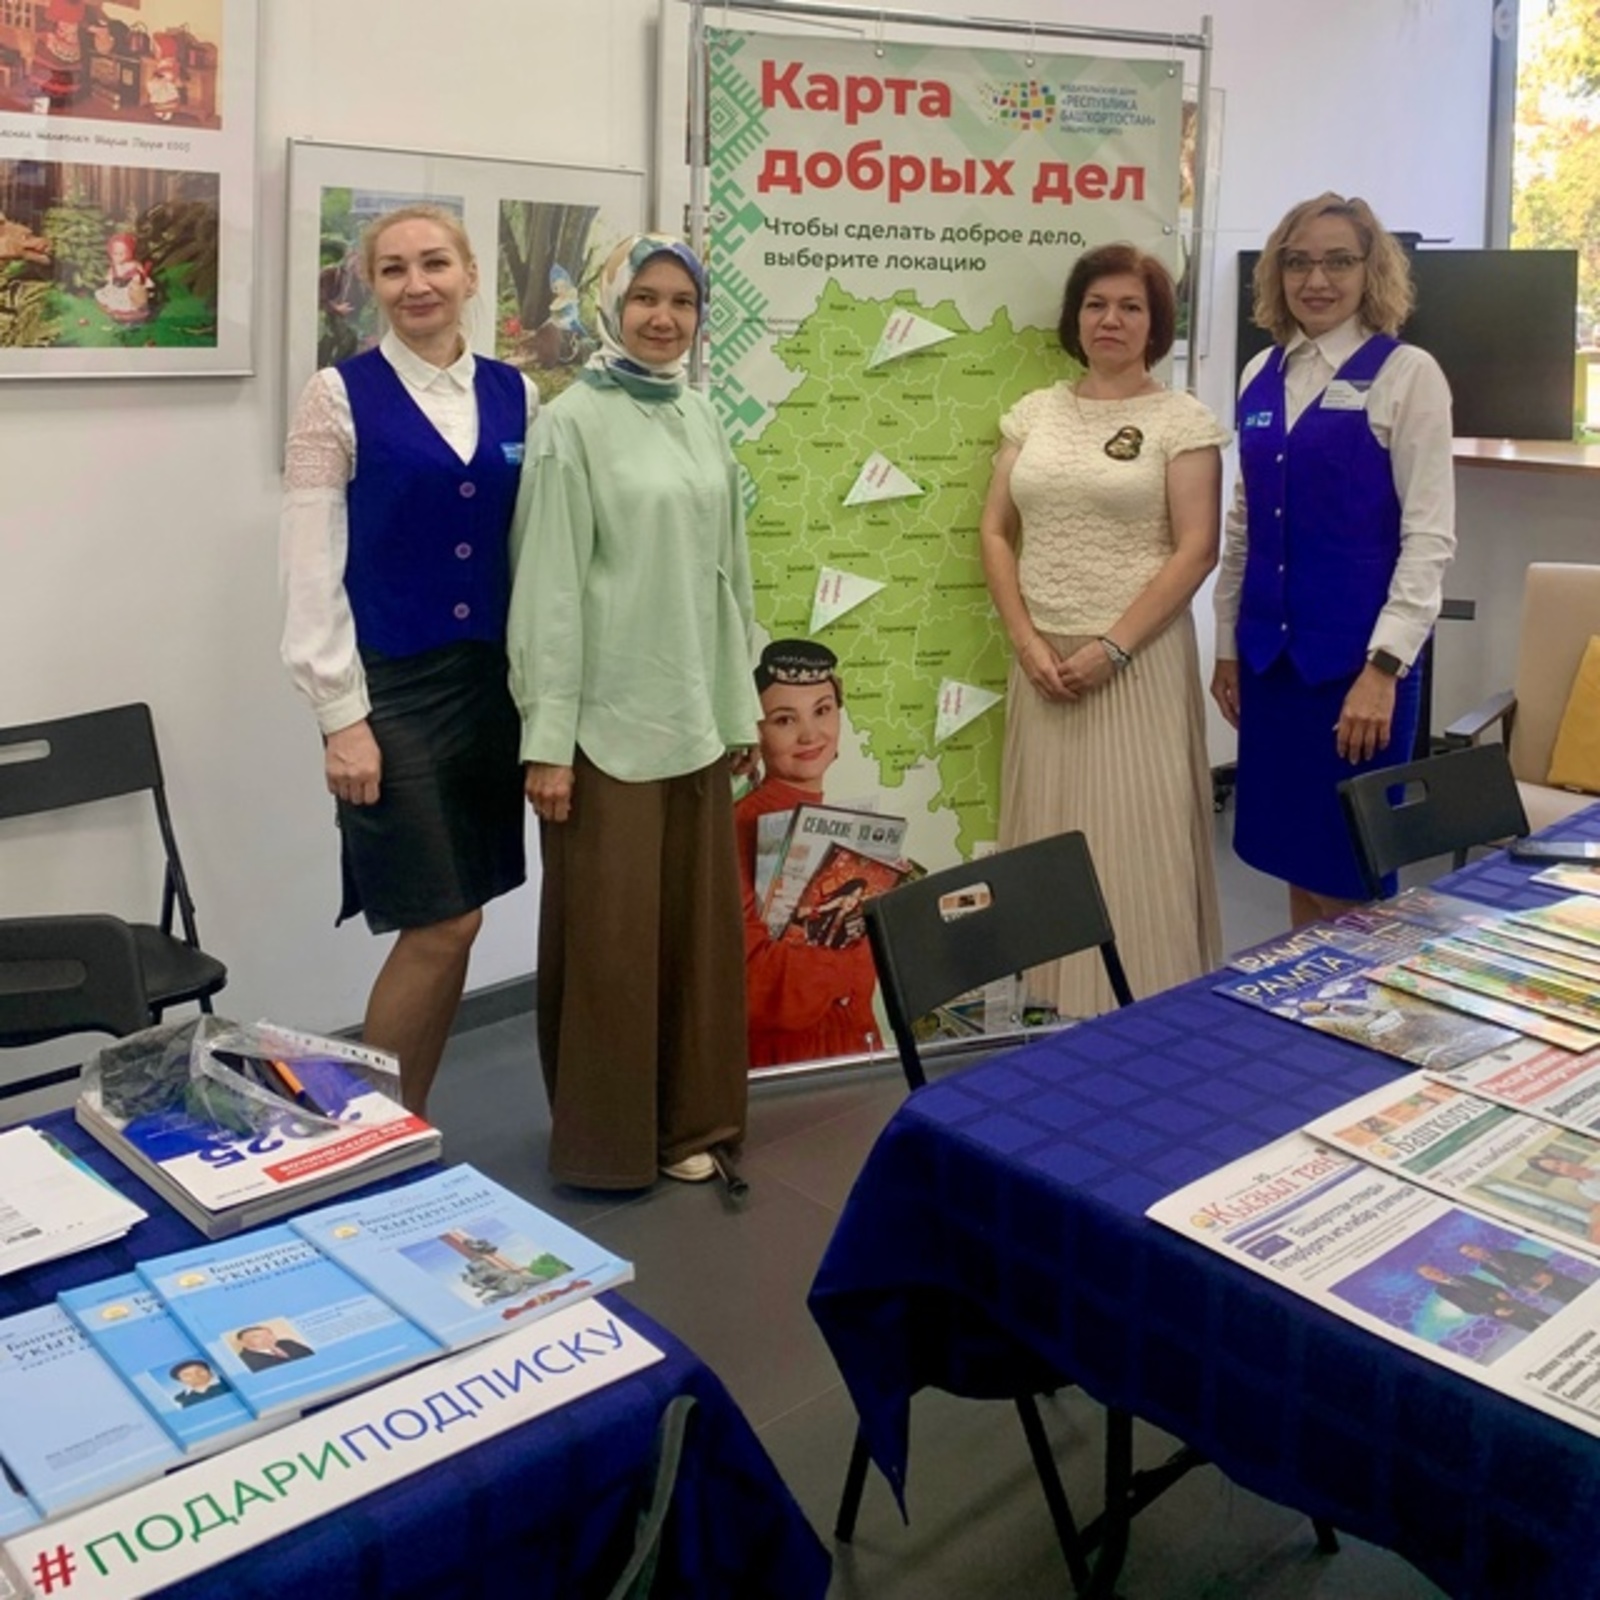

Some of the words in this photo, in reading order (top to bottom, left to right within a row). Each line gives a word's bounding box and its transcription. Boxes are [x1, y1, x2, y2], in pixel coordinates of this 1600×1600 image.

[760, 60, 952, 125] Карта
[758, 139, 1016, 203] добрых
[1032, 161, 1146, 205] дел
[764, 217, 838, 238] Чтобы
[845, 222, 935, 244] сделать
[941, 223, 1023, 247] доброе
[1029, 229, 1086, 248] дело,
[764, 250, 879, 274] выберите
[885, 254, 986, 275] локацию
[32, 1319, 625, 1596] #ПОДАРИПОДПИСКУ
